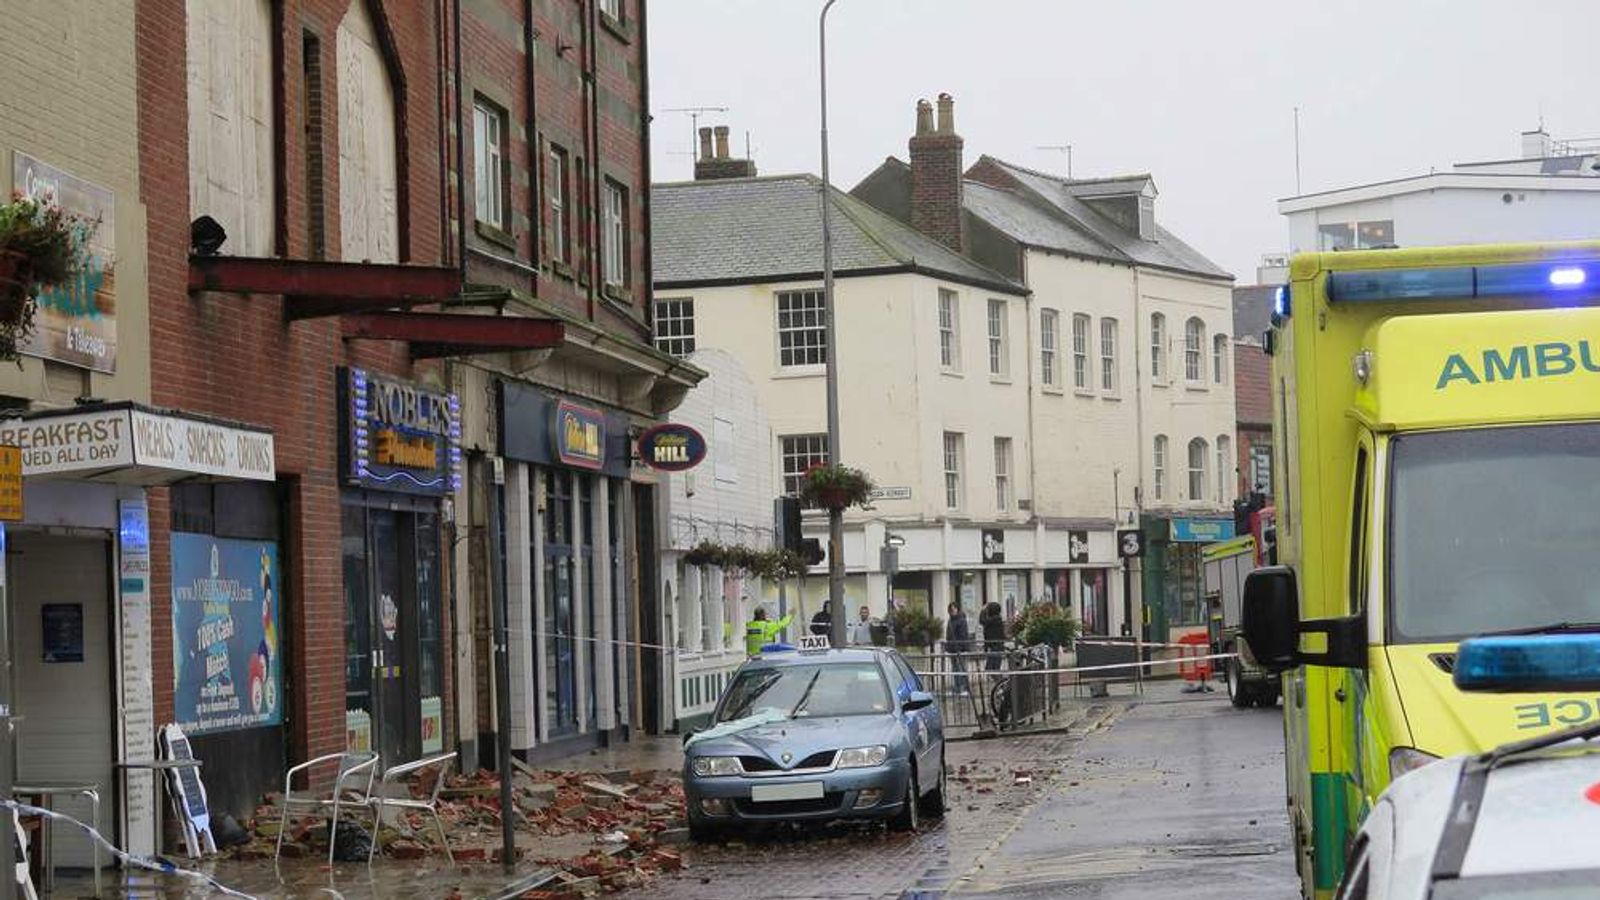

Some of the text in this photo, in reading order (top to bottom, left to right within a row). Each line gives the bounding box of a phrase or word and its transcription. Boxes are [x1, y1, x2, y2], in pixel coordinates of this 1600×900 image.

[369, 380, 451, 436] NOBLES
[0, 418, 123, 449] REAKFAST
[136, 417, 270, 473] MEALS SNACKS DRINKS
[22, 443, 119, 467] VED ALL DAY
[654, 446, 690, 462] HILL
[1123, 532, 1139, 556] 3
[800, 637, 827, 649] TAXI
